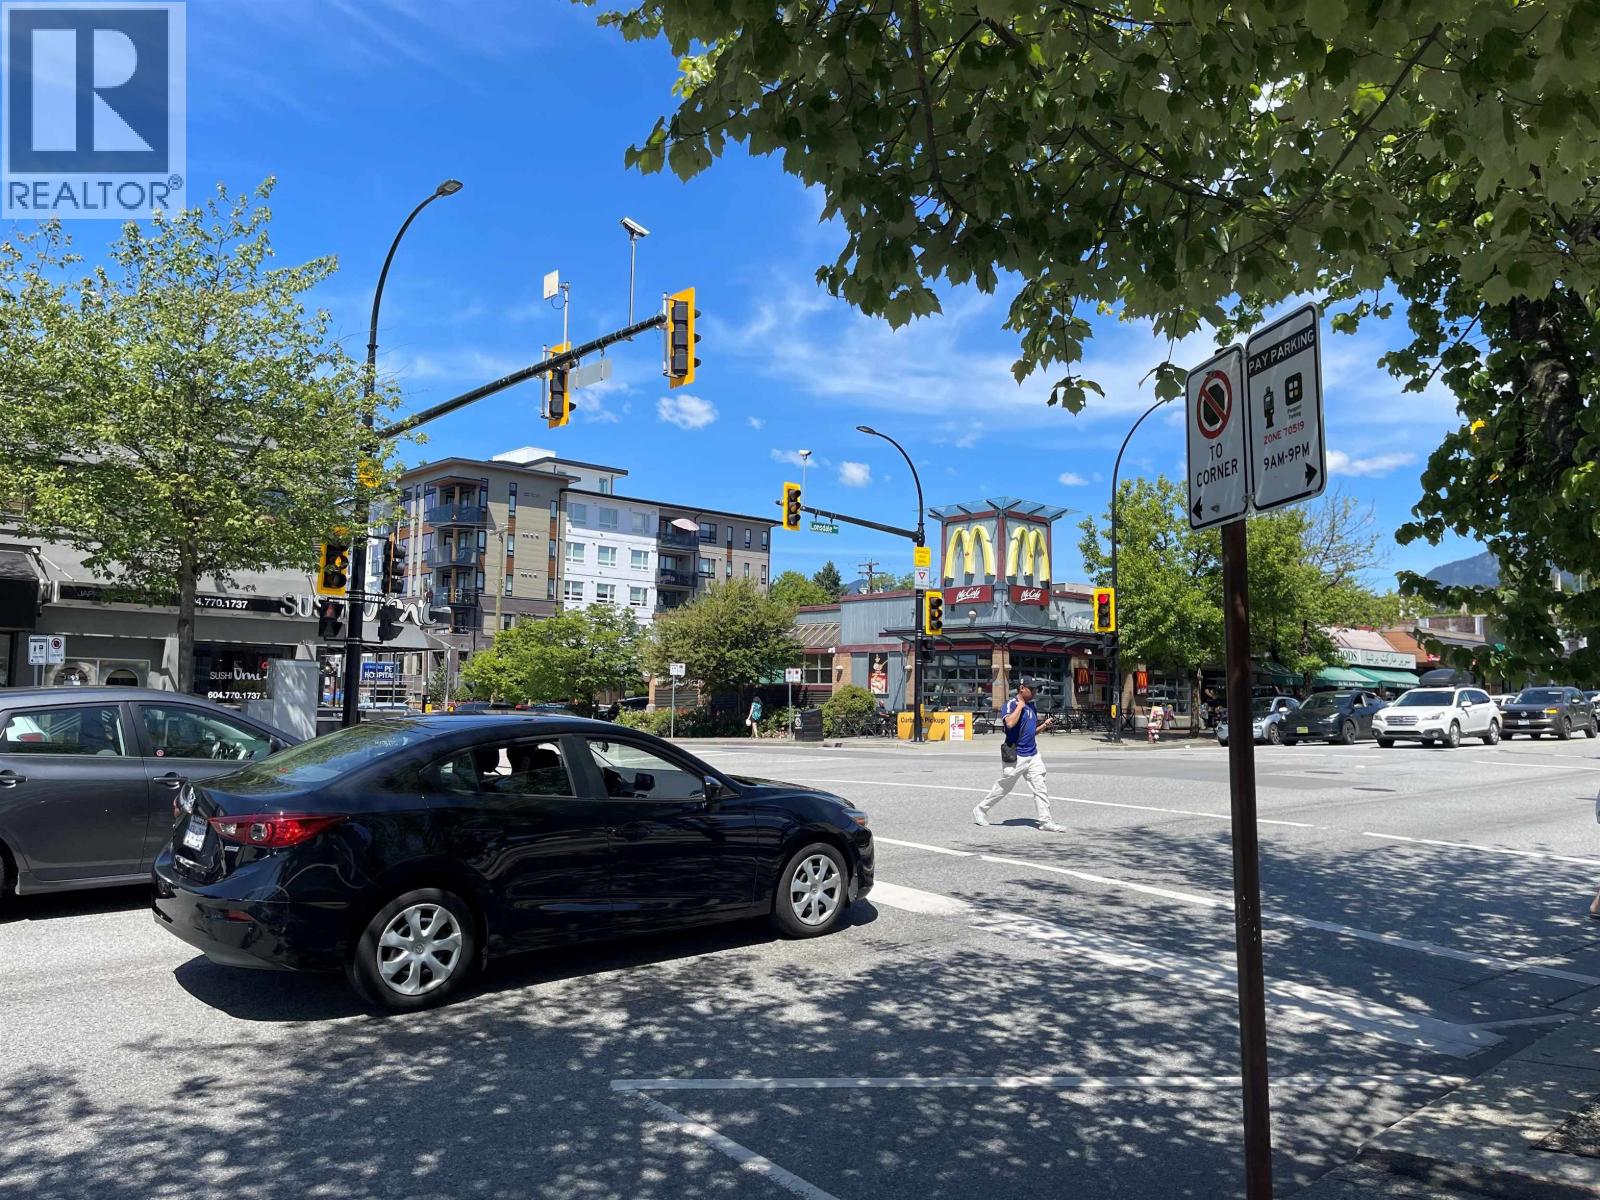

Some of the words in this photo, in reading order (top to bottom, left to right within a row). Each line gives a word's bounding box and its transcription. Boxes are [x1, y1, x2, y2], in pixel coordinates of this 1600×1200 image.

[1248, 353, 1269, 374] PAY
[1270, 329, 1314, 363] PARKING
[1263, 430, 1281, 445] ZONE
[1283, 420, 1305, 436] 70519
[1209, 442, 1223, 461] TO
[1263, 441, 1310, 472] 9AM-9PM
[1196, 458, 1239, 488] CORNER
[194, 597, 249, 609] 4.770.1737
[210, 671, 232, 680] SUSHI
[207, 691, 261, 700] 604.770.1737
